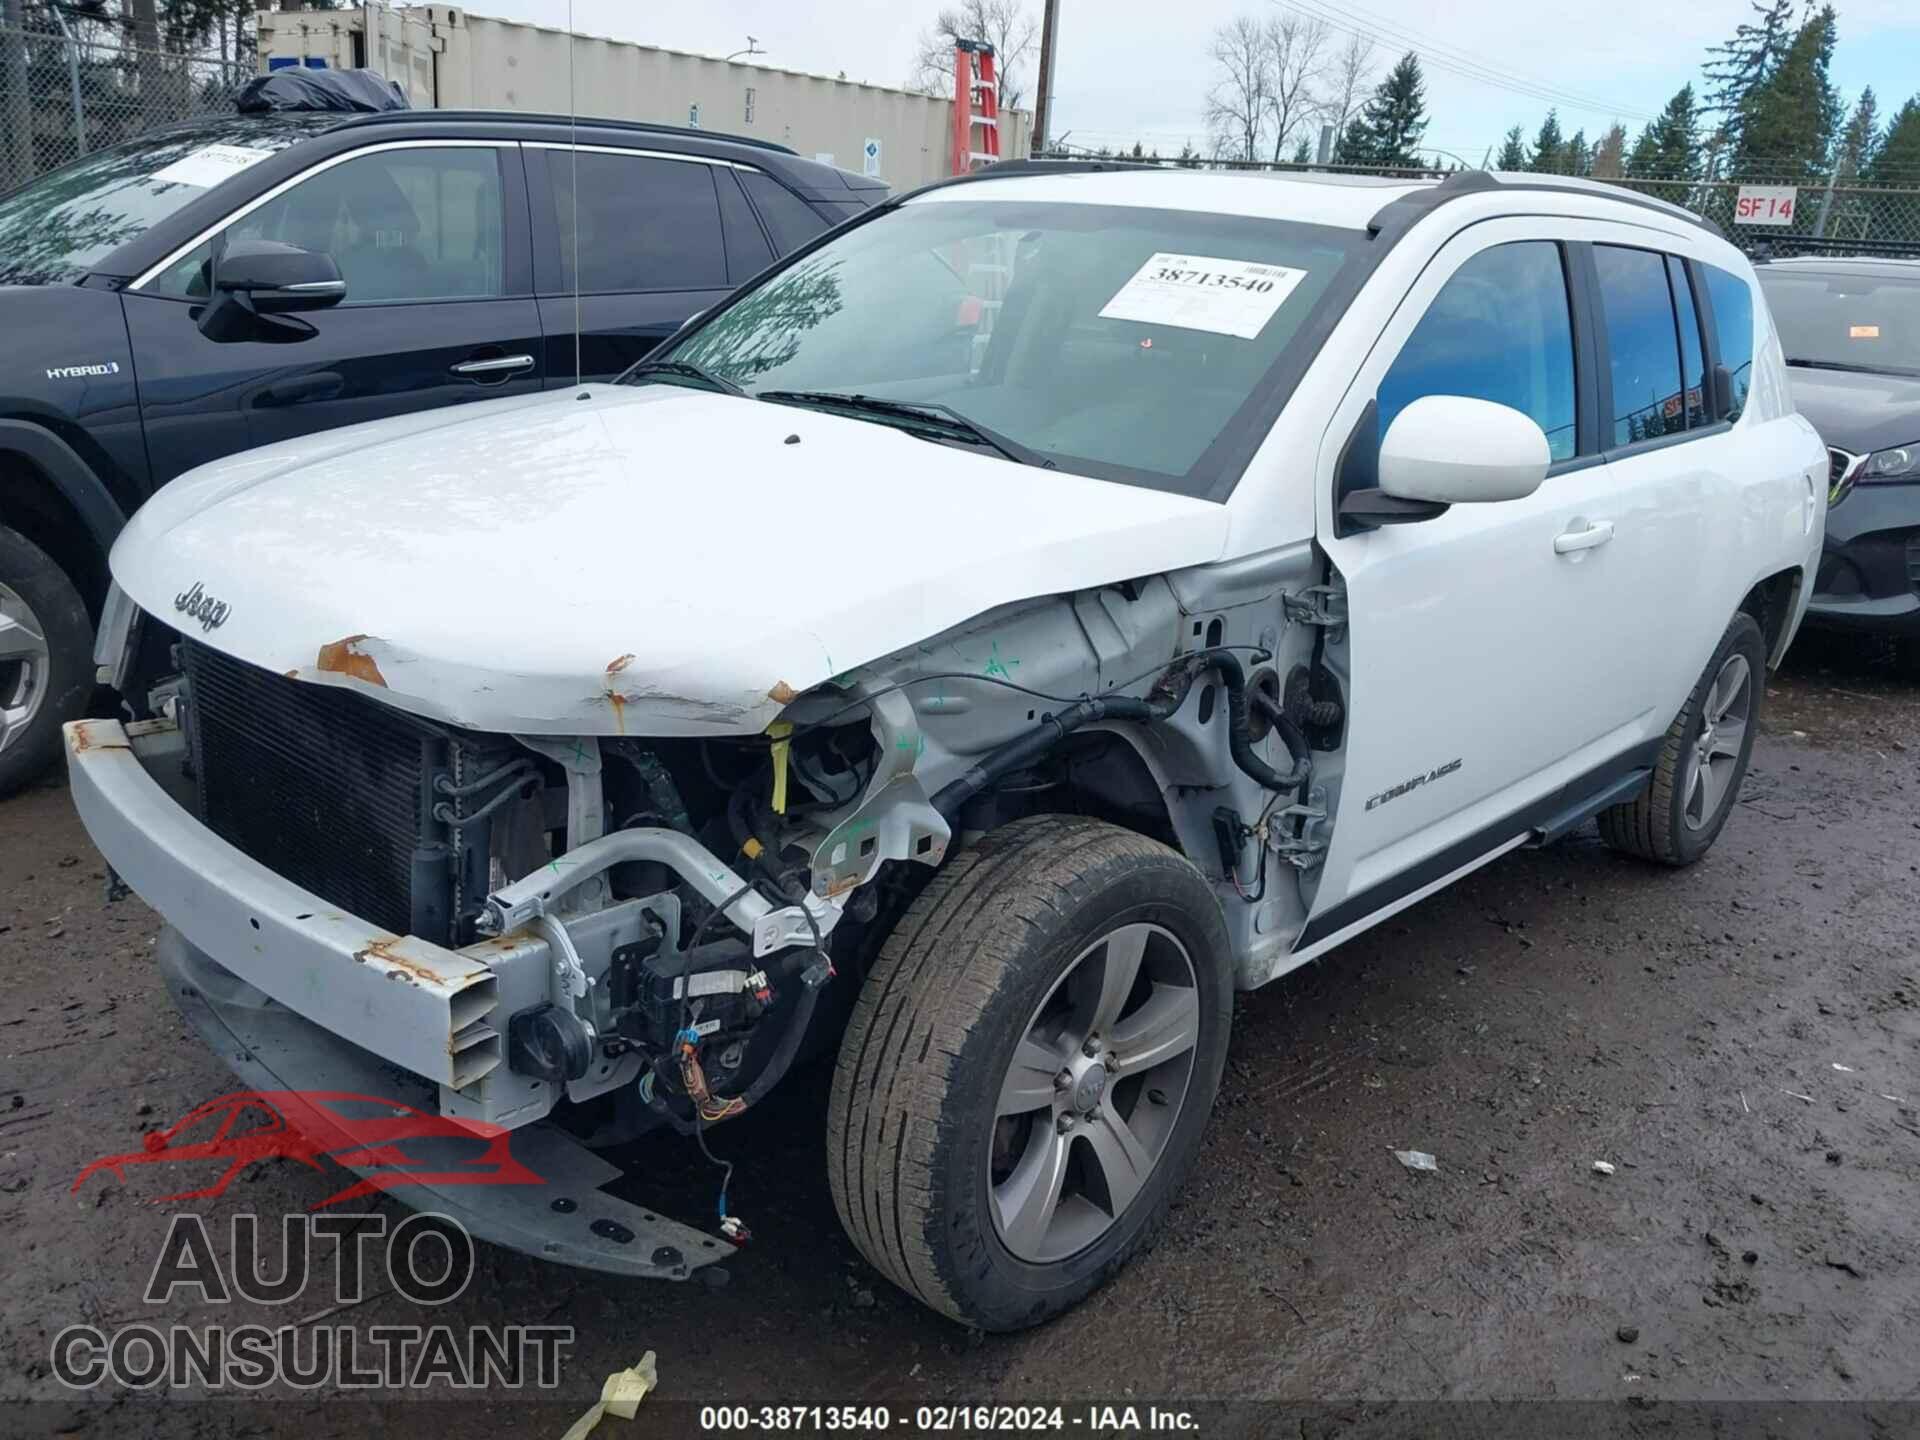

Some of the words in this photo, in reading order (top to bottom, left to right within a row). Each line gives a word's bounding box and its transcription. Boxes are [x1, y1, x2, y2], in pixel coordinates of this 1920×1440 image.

[1149, 268, 1274, 294] 38713540
[46, 364, 107, 379] HYBRID
[175, 581, 232, 632] Jeep
[1364, 758, 1462, 811] COMPASS
